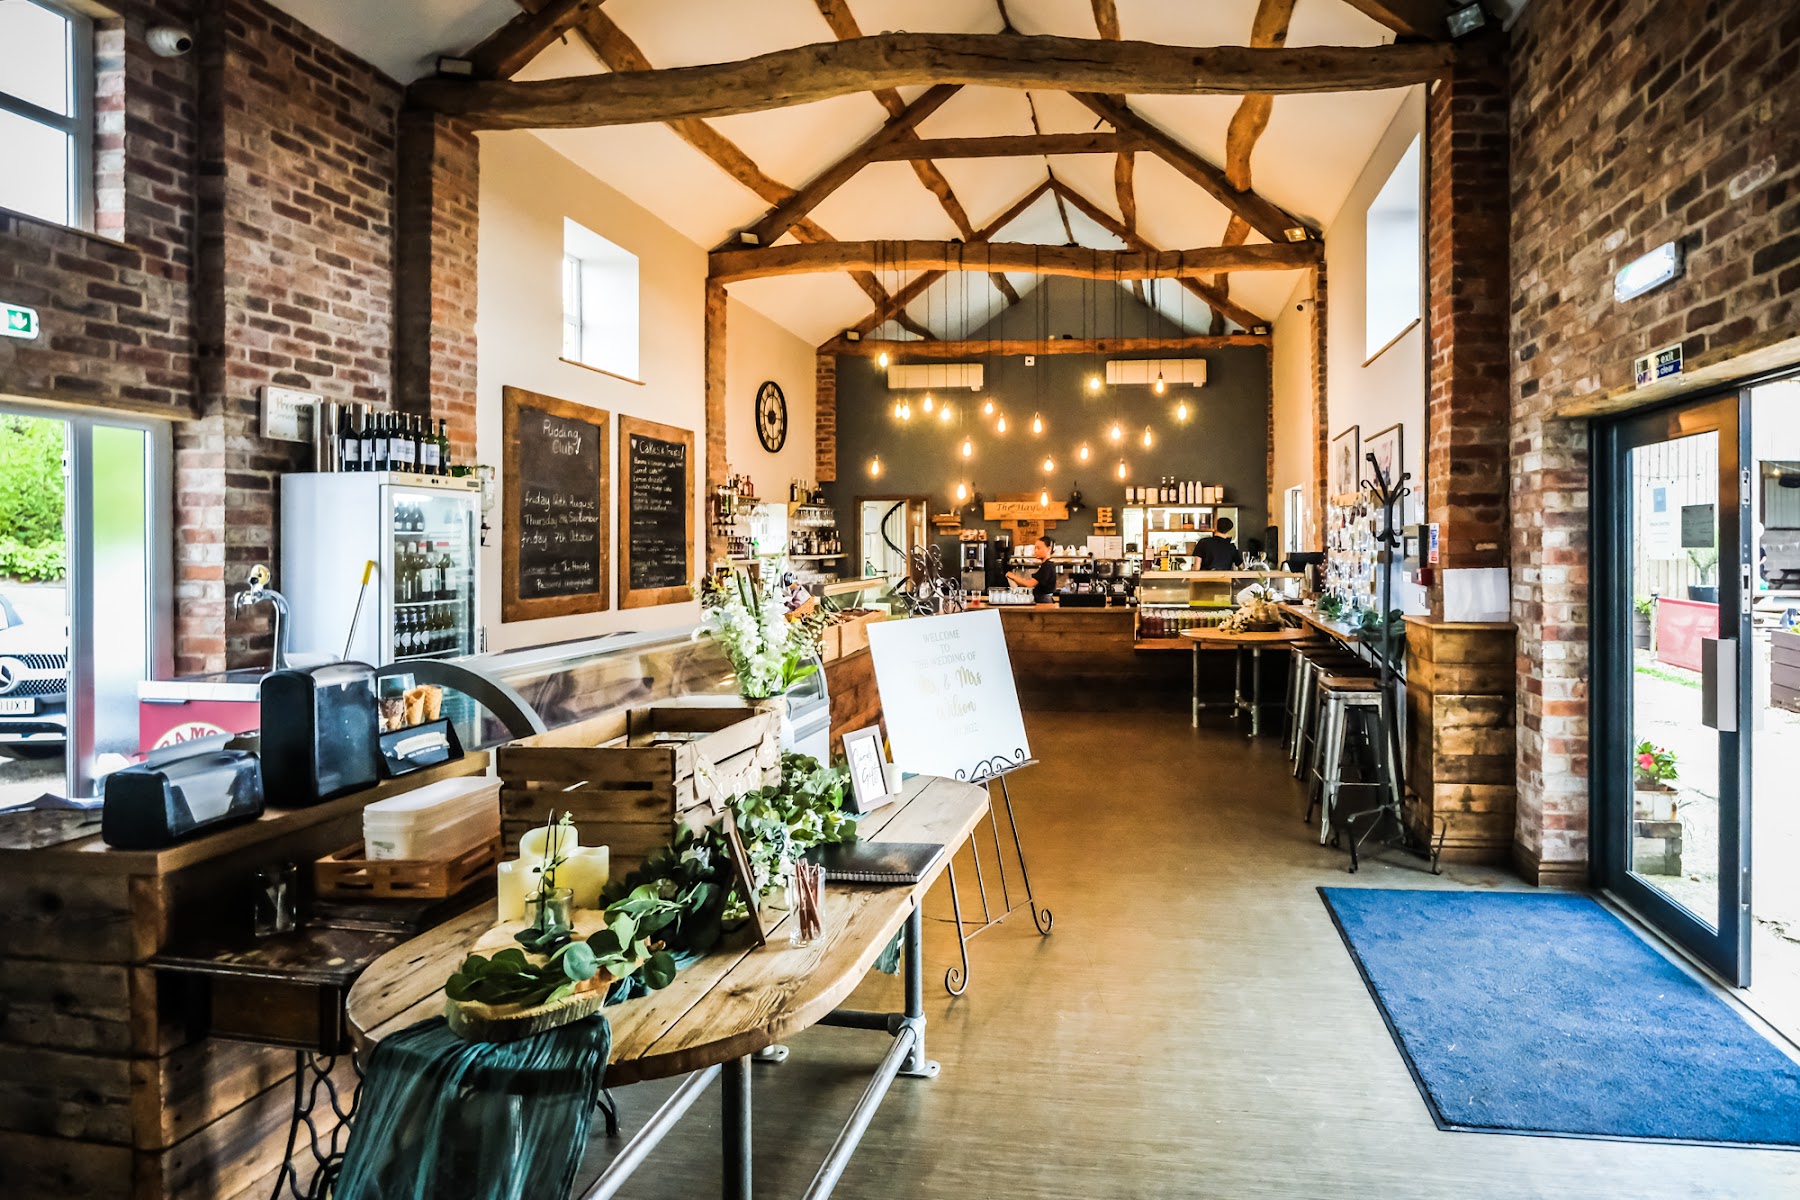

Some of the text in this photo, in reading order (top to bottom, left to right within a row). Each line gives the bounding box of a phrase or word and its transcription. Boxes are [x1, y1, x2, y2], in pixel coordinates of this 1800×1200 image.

[543, 419, 579, 445] Pudding
[524, 514, 558, 528] Thursday
[568, 510, 599, 527] September
[923, 629, 960, 644] WELCOME
[940, 643, 951, 654] TO
[930, 652, 966, 667] WEDDING
[967, 651, 977, 662] OF
[955, 665, 982, 689] Mrs
